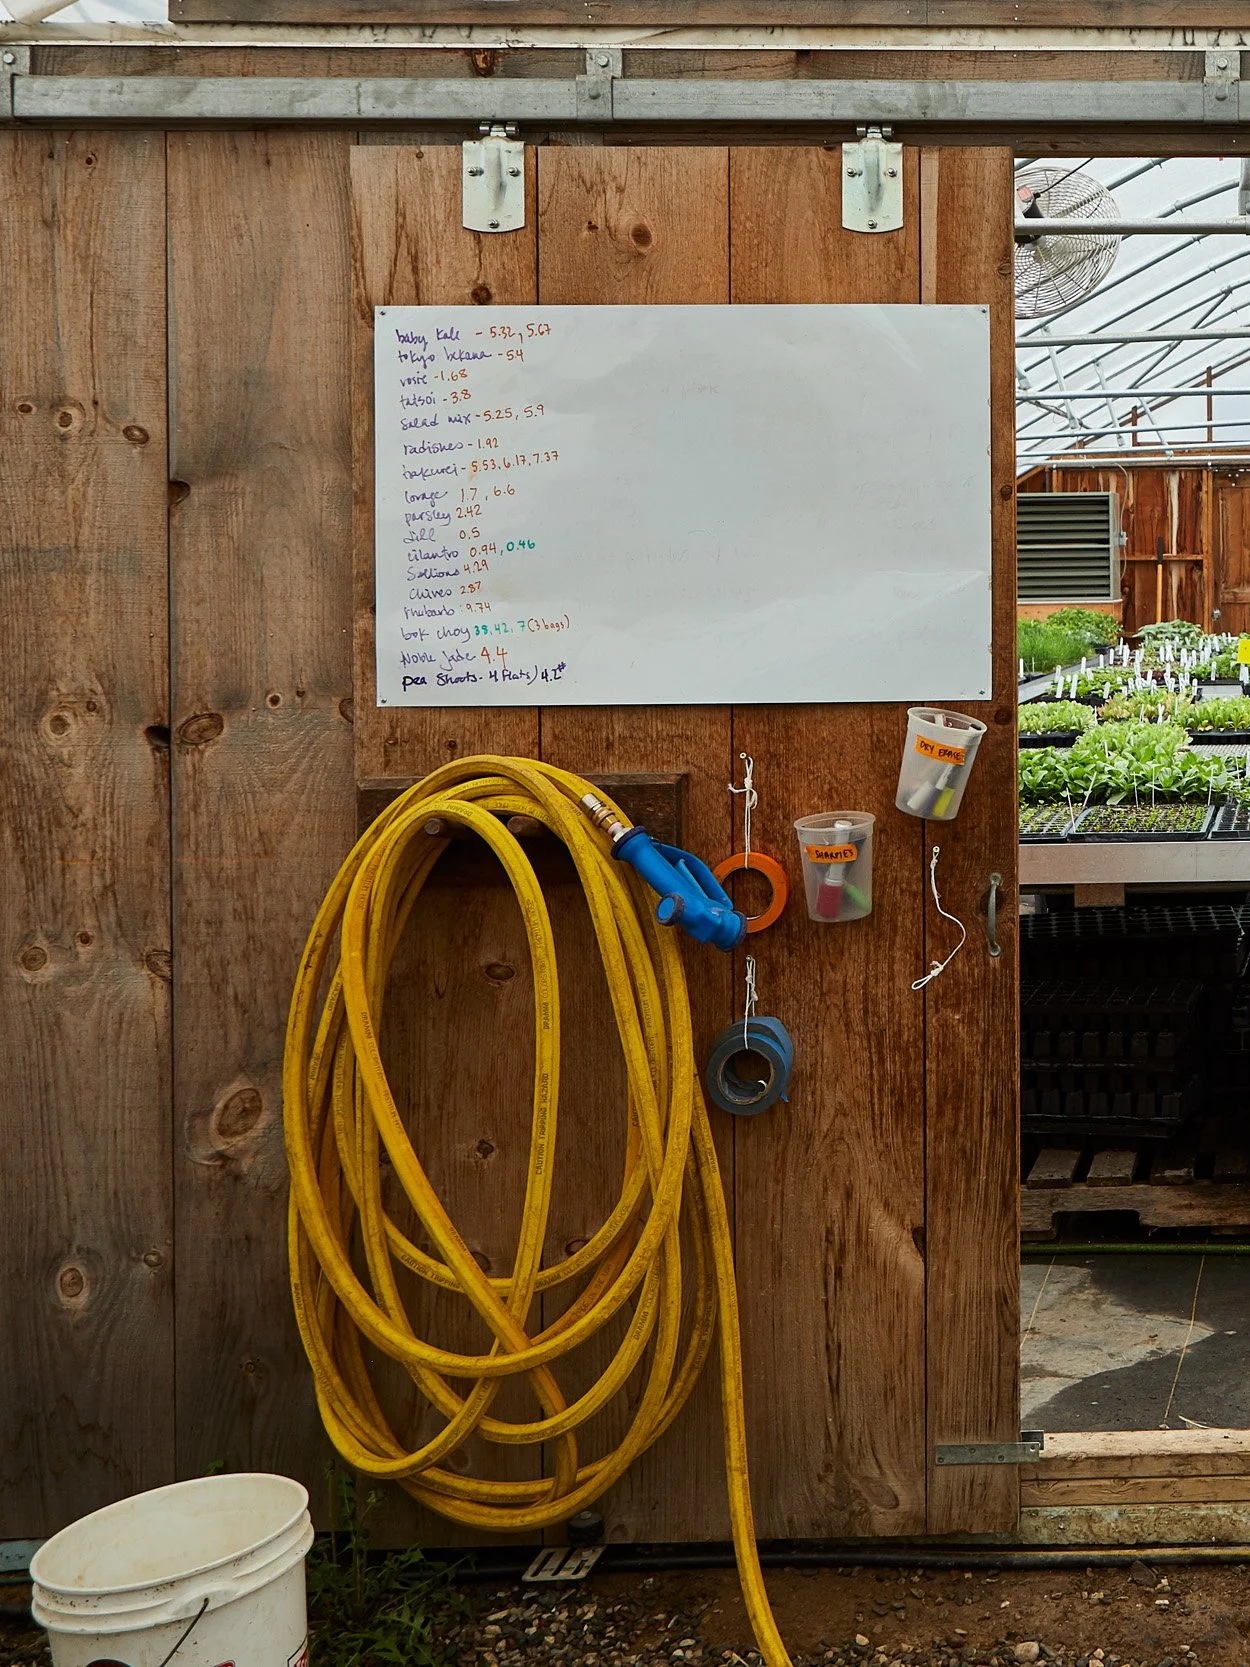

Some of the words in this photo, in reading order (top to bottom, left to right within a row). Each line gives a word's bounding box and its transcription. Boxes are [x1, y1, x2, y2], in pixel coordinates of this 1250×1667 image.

[396, 329, 428, 350] baby
[526, 323, 551, 337] 5.67
[400, 392, 436, 409] tatsoi
[448, 414, 471, 425] mix
[532, 450, 559, 464] 7.37
[405, 490, 448, 507] lovage
[405, 509, 451, 526] parsley
[455, 504, 482, 519] 2.42
[403, 528, 436, 544] dill
[459, 527, 481, 540] 0.5
[506, 540, 536, 551] 0.46
[463, 559, 489, 574] 4.29
[460, 581, 481, 595] 2.87
[402, 674, 428, 692] pea
[489, 670, 499, 682] 4
[920, 741, 934, 754] DRY
[938, 748, 961, 761] ERASE
[814, 849, 854, 859] SHARPIES
[542, 1001, 550, 1030] DRAMM
[541, 1073, 550, 1104] HAZARD
[538, 1107, 548, 1140] TRIPPING
[535, 1143, 545, 1176] CAUTION
[401, 1254, 428, 1275] CAUTION
[633, 1310, 649, 1341] DRAMM
